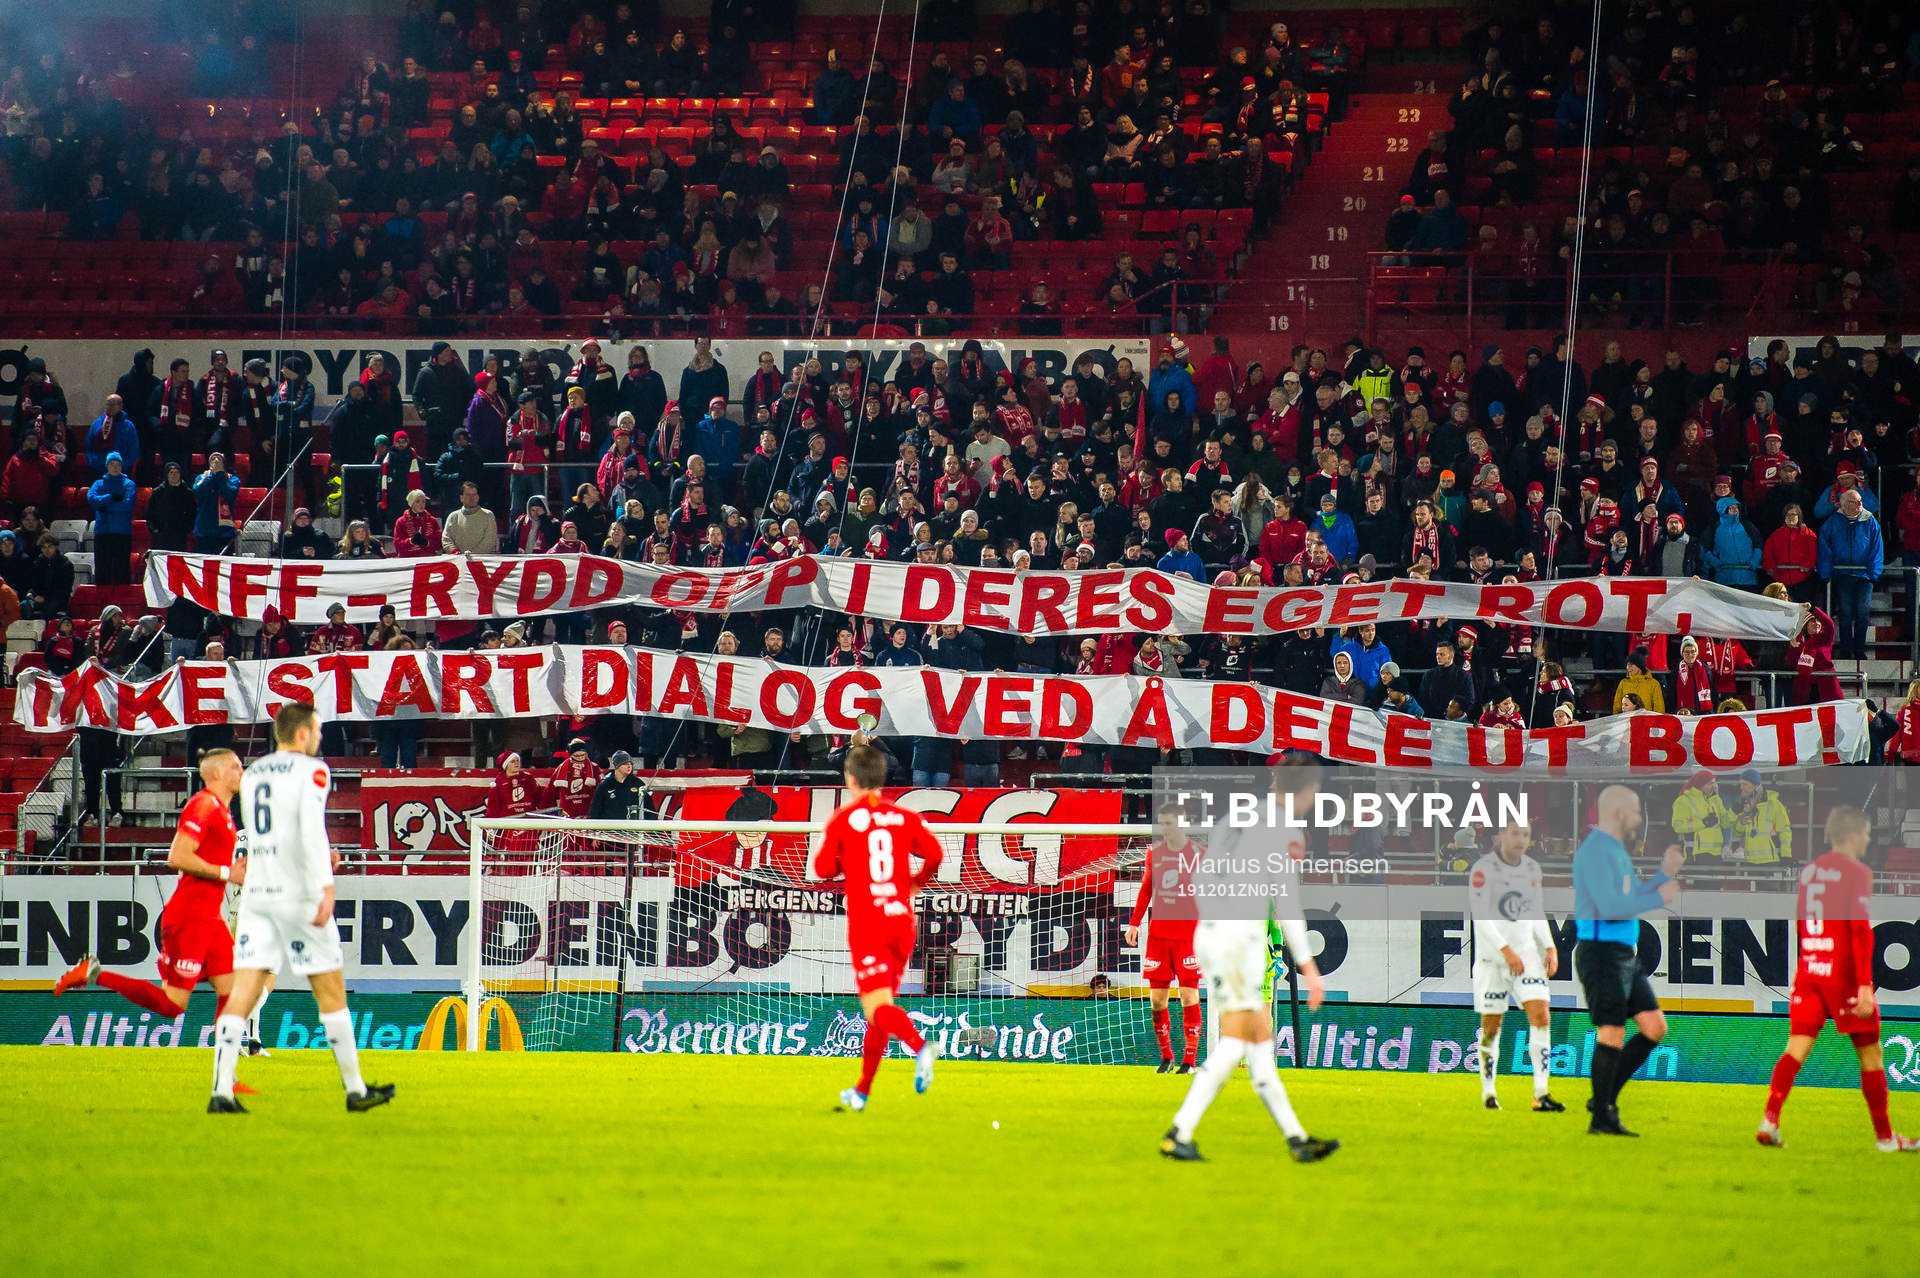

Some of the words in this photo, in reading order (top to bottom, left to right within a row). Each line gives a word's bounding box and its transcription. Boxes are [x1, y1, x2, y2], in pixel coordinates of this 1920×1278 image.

[1414, 80, 1436, 94] 24
[1398, 108, 1421, 123] 23
[1386, 137, 1409, 152] 22
[1363, 166, 1385, 181] 21
[1343, 196, 1366, 211] 20
[1327, 226, 1348, 241] 19
[1310, 254, 1330, 270] 18
[1269, 315, 1289, 331] 16
[167, 555, 324, 620] NFF
[410, 557, 625, 617] RYDD
[650, 555, 819, 610] OPP
[844, 563, 873, 614] I
[900, 566, 1175, 636] DERES
[1203, 580, 1446, 633] EGET
[31, 659, 229, 732] IKKE
[266, 651, 544, 721] START
[581, 649, 883, 731] DIALOG
[920, 669, 1094, 740] VED
[1120, 675, 1175, 748] Å
[1209, 683, 1434, 768] DELE
[1466, 725, 1586, 776] UT
[1630, 706, 1841, 775] BOT!
[254, 783, 272, 836] 6
[868, 829, 894, 882] 8
[727, 888, 834, 912] BERGENS
[931, 893, 1029, 916] GUTTER
[1805, 884, 1826, 936] 5
[0, 900, 163, 966] NB
[41, 1010, 185, 1047] Alltid
[622, 1007, 811, 1056] Bergens
